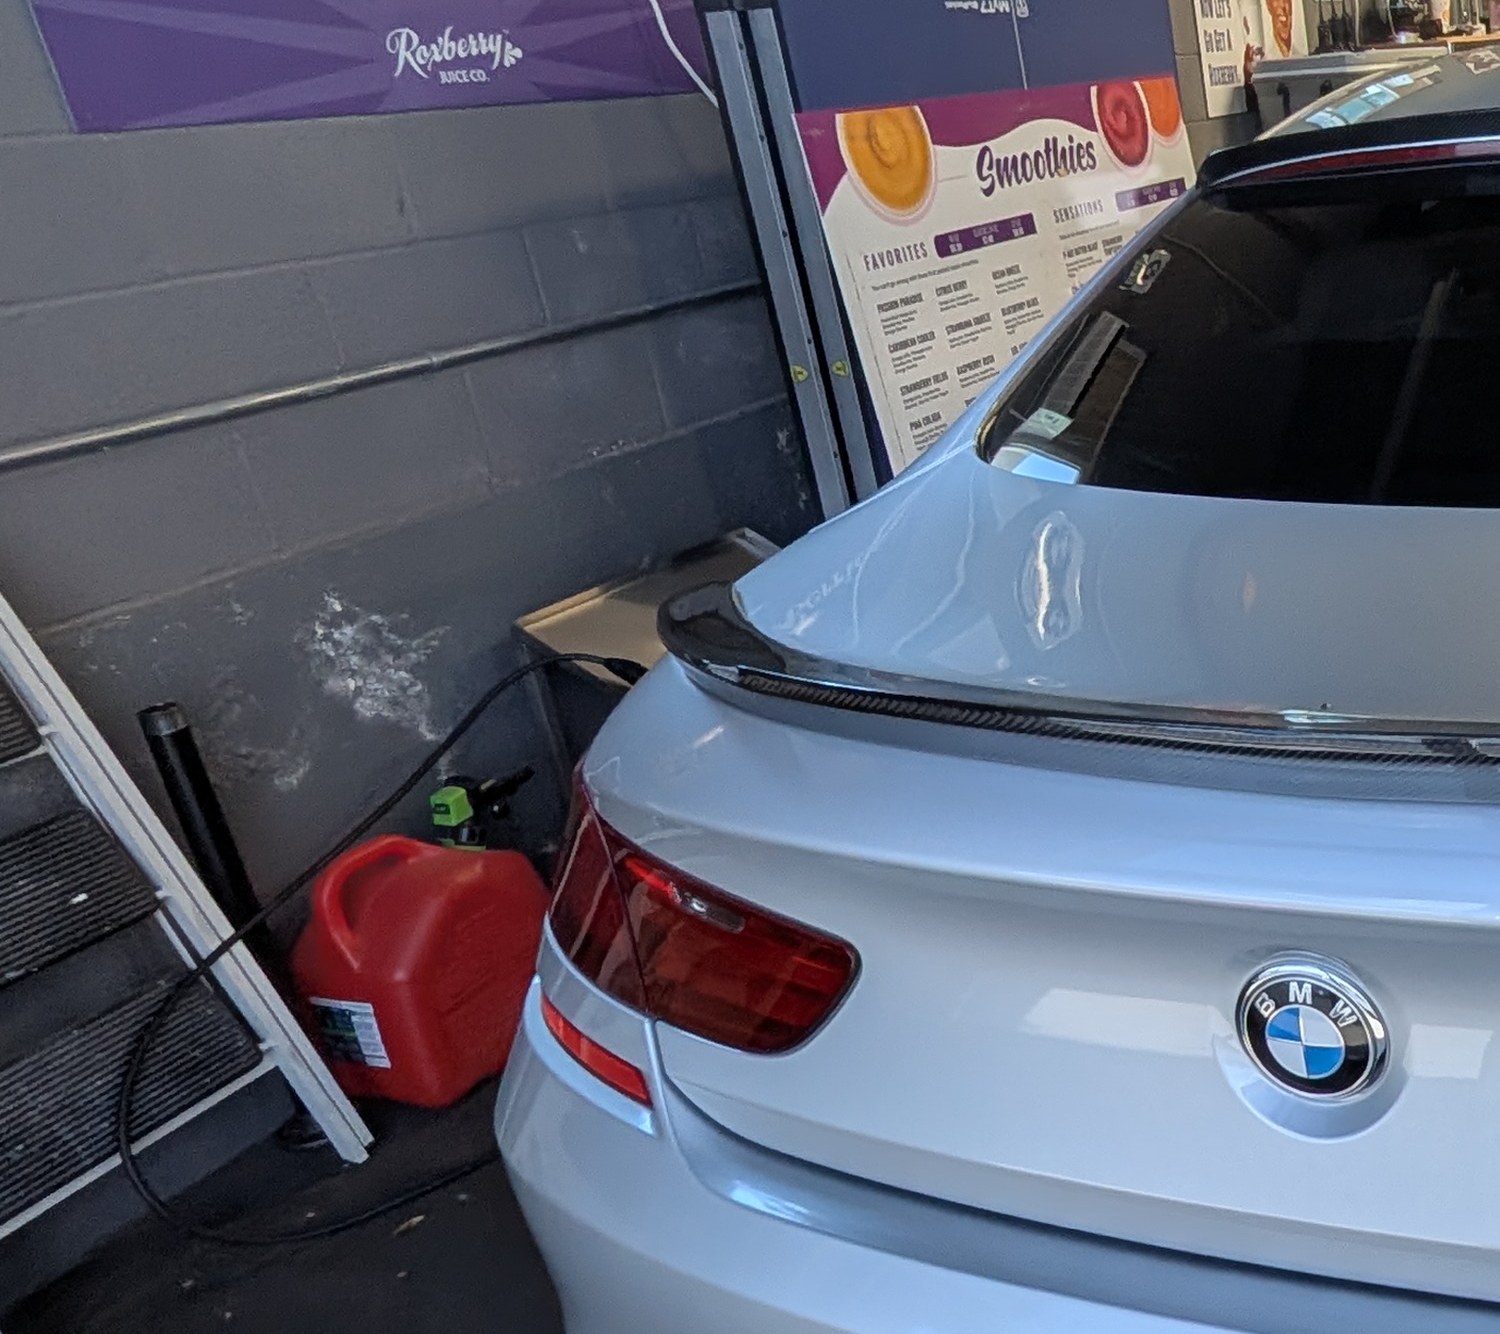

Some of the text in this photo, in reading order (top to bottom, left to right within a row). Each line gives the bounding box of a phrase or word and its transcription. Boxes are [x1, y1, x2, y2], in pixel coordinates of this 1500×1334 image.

[386, 26, 504, 78] Roxberry
[1214, 29, 1226, 52] GET
[439, 69, 470, 84] JUICE
[976, 135, 1097, 197] Smoothies
[1053, 199, 1103, 223] SENSATIONS
[863, 242, 928, 271] FAVORITES
[1254, 981, 1359, 1029] BMW
